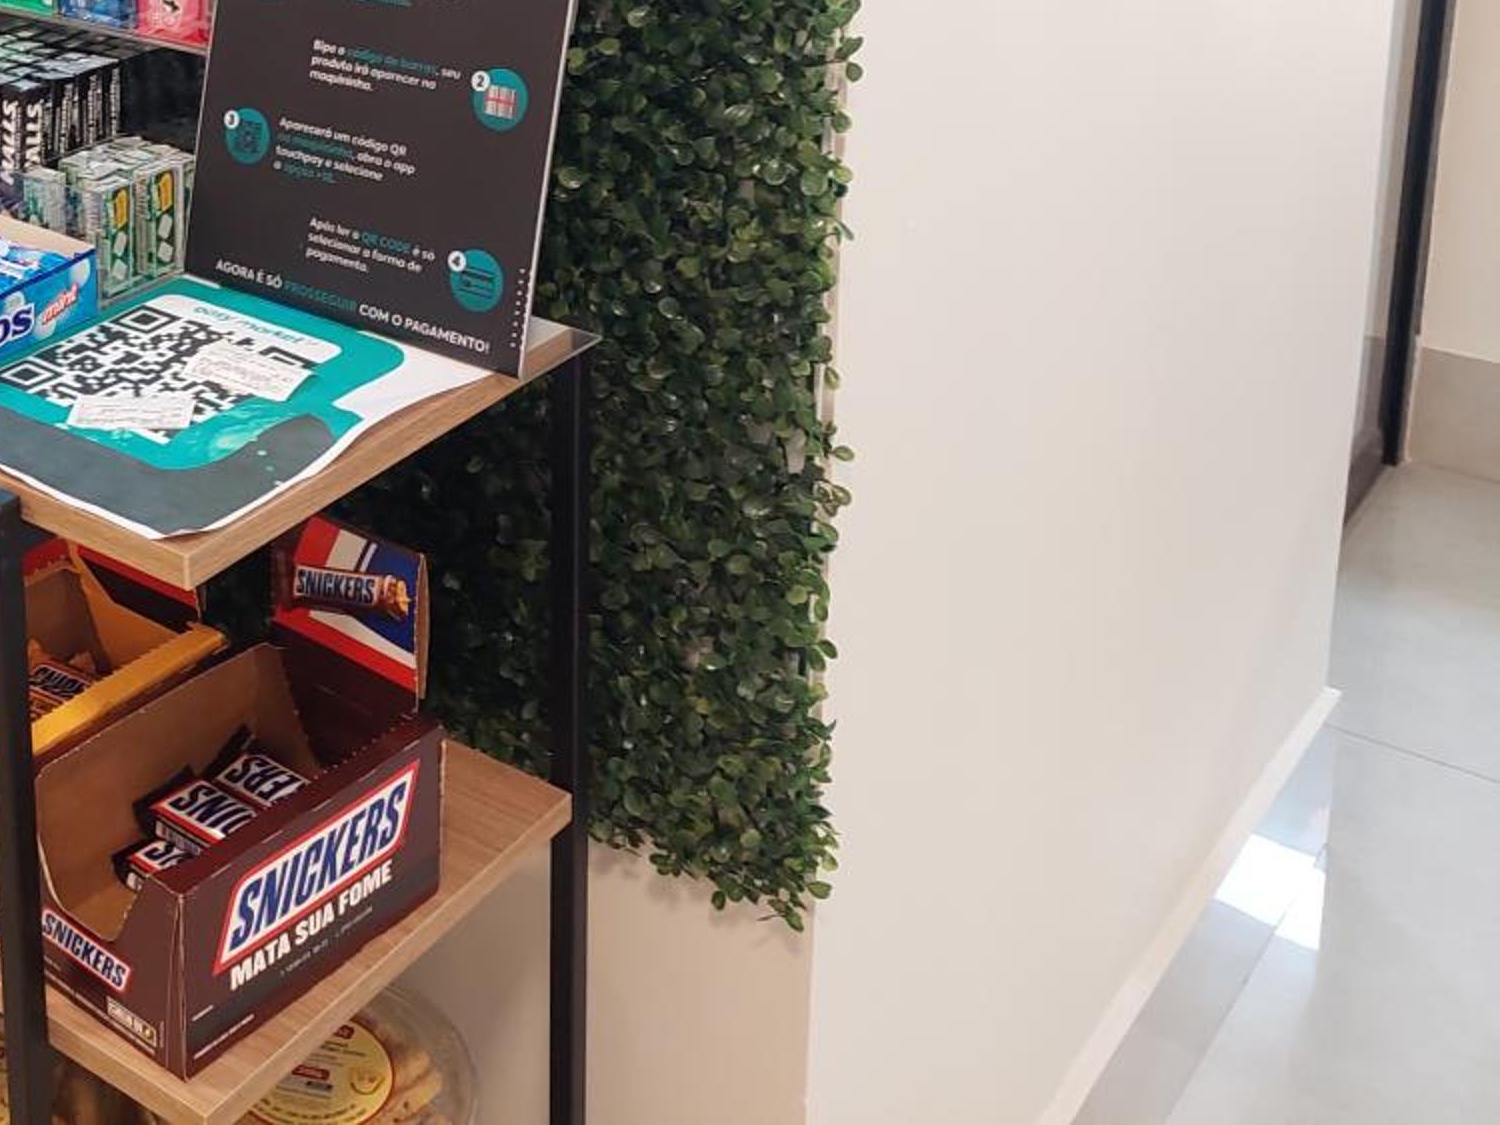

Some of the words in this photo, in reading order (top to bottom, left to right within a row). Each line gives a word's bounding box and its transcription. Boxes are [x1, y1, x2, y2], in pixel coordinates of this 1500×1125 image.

[41, 282, 79, 325] mint
[215, 259, 255, 281] AGORA
[265, 271, 283, 290] SÓ
[358, 304, 390, 322] COM
[391, 313, 403, 327] O
[404, 317, 491, 354] PAGAMENTO!
[297, 569, 375, 604] SNICKERS
[229, 779, 408, 950] SNICKERS
[42, 911, 128, 989] SNICKERS
[230, 937, 291, 991] MATA
[294, 904, 335, 945] SUA
[337, 860, 394, 916] FOME
